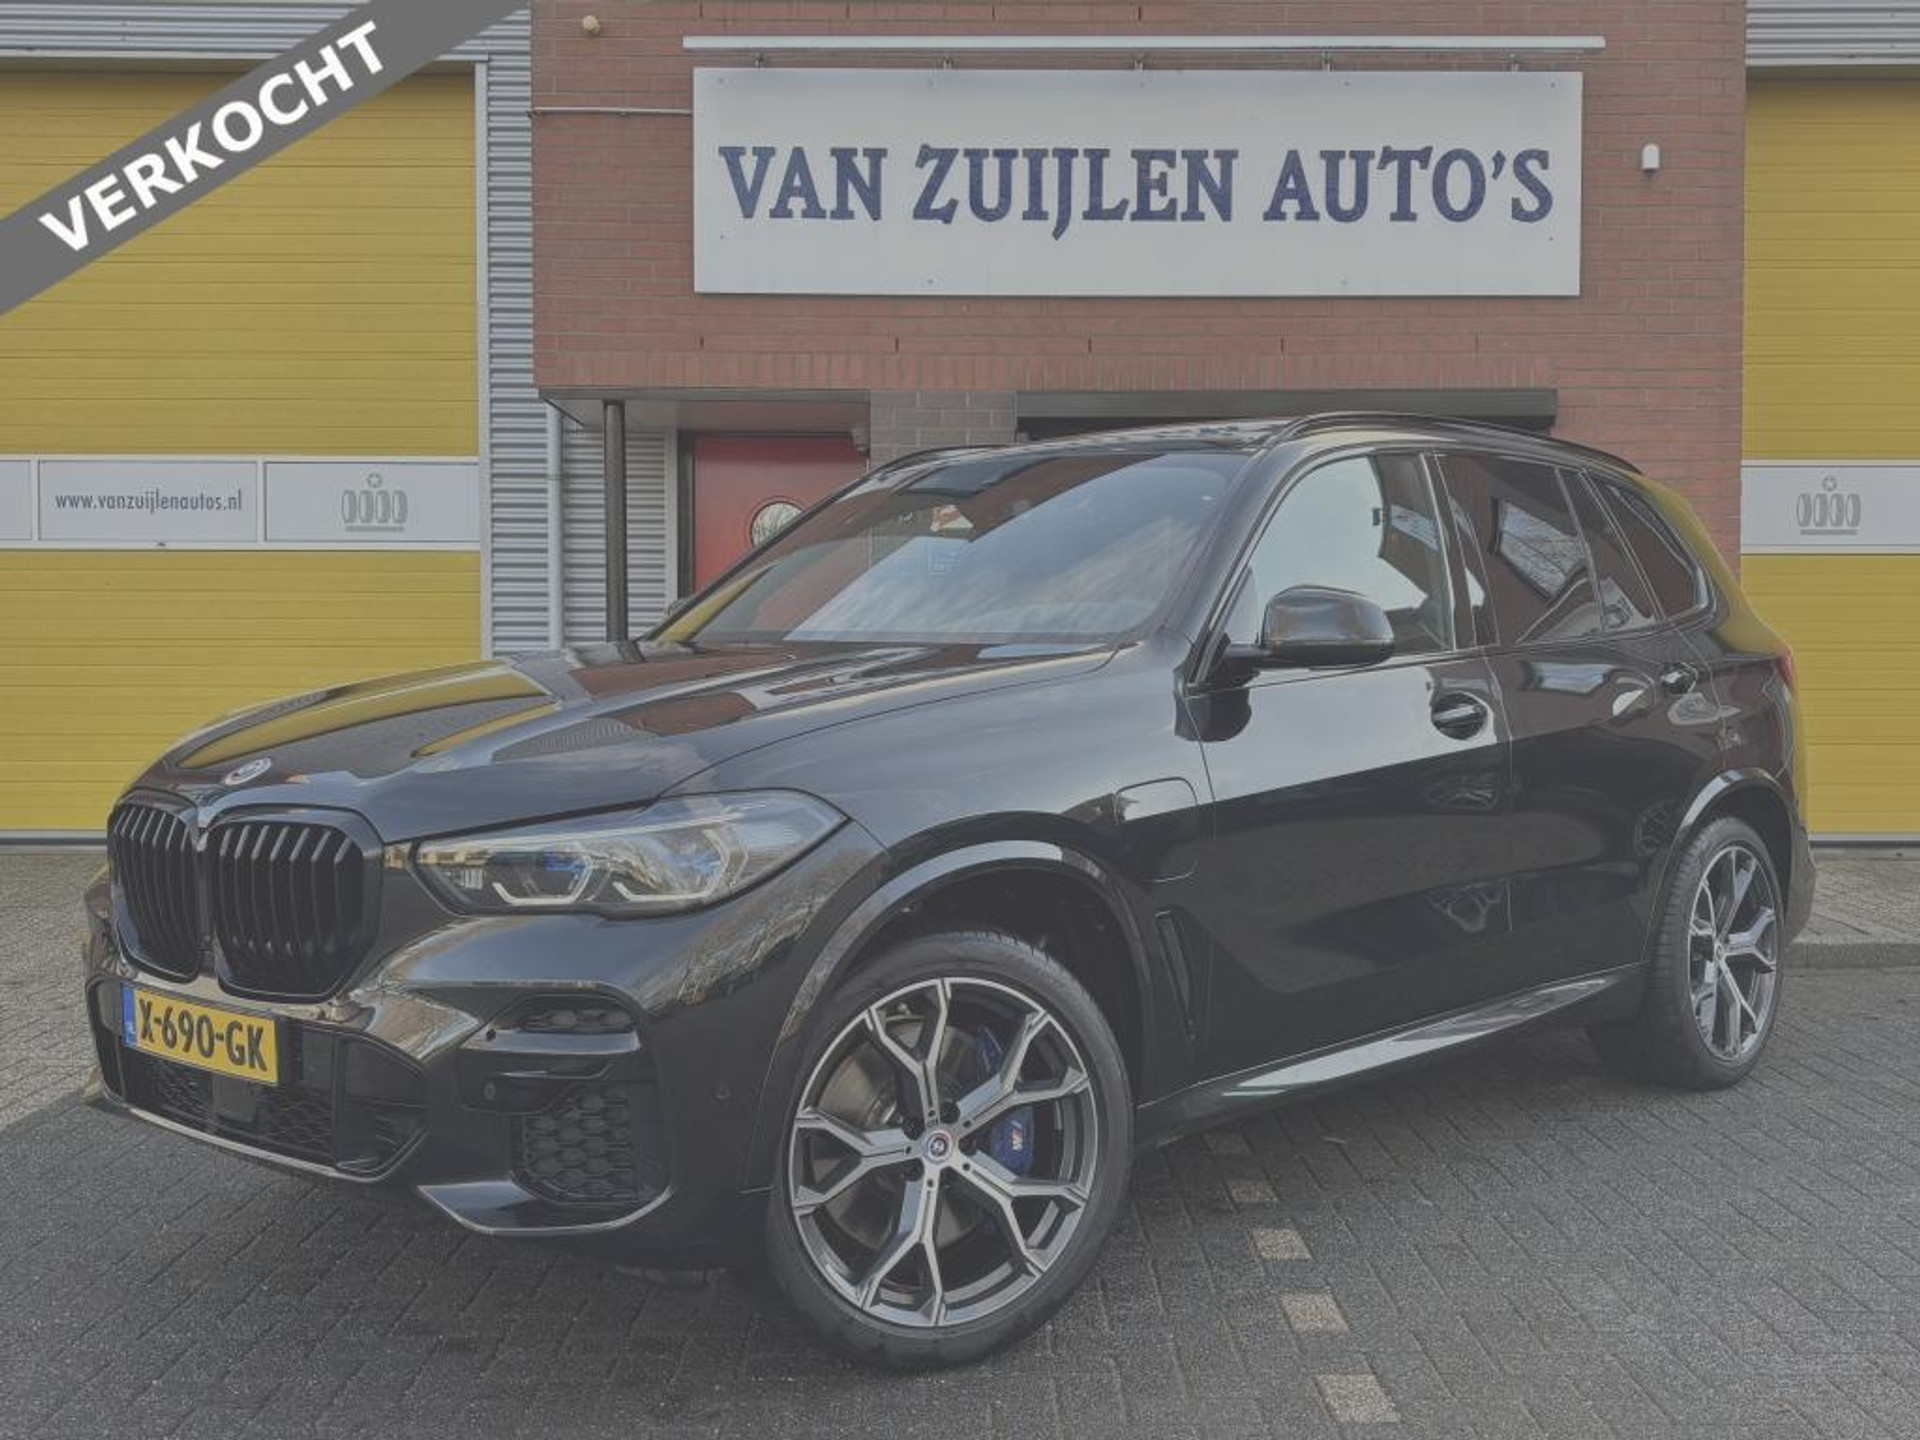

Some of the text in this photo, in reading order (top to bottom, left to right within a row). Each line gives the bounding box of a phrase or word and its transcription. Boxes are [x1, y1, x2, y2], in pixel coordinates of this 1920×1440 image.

[718, 143, 1554, 241] VAN ZUIJLEN AUTO'S
[54, 487, 243, 515] www.vanzuijlenautos.nl
[138, 998, 268, 1072] X-690-GK
